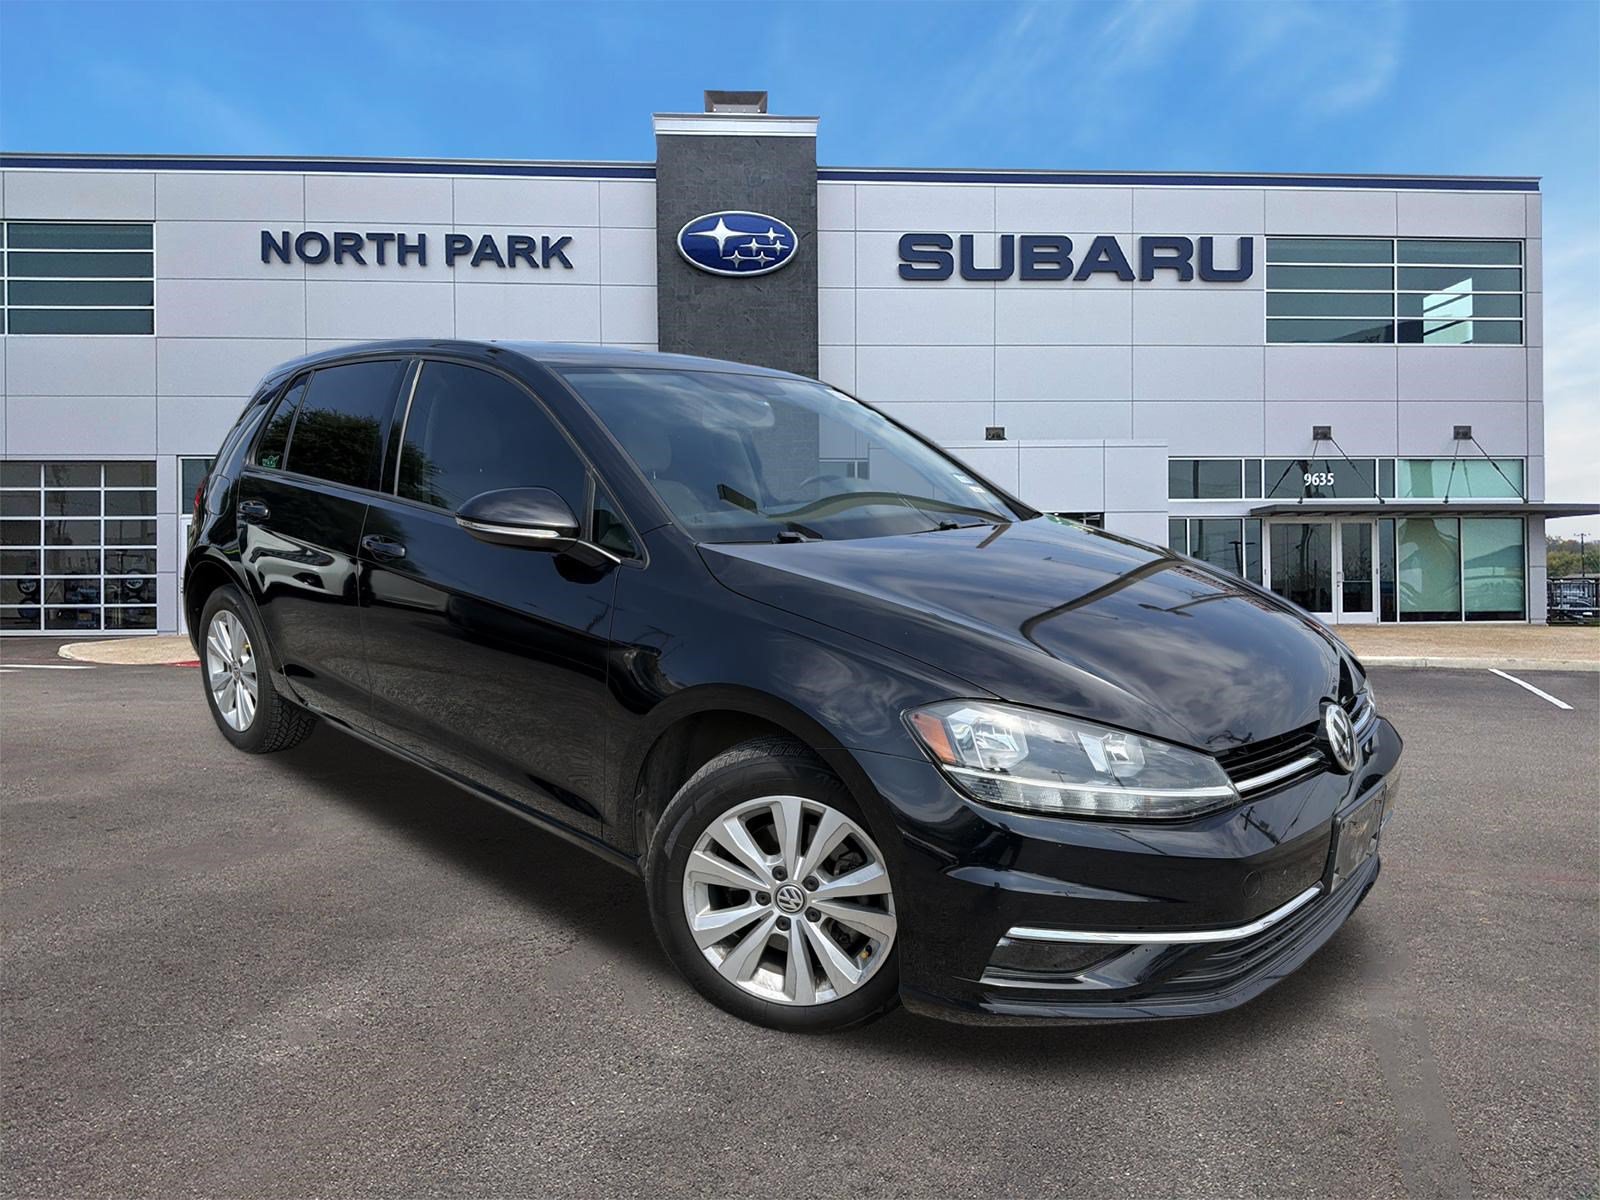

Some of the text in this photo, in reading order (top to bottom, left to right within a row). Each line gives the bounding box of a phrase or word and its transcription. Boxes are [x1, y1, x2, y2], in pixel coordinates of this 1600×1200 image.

[261, 230, 574, 270] NORTH PARK
[898, 233, 1254, 283] SUBARU
[1303, 472, 1335, 486] 9635
